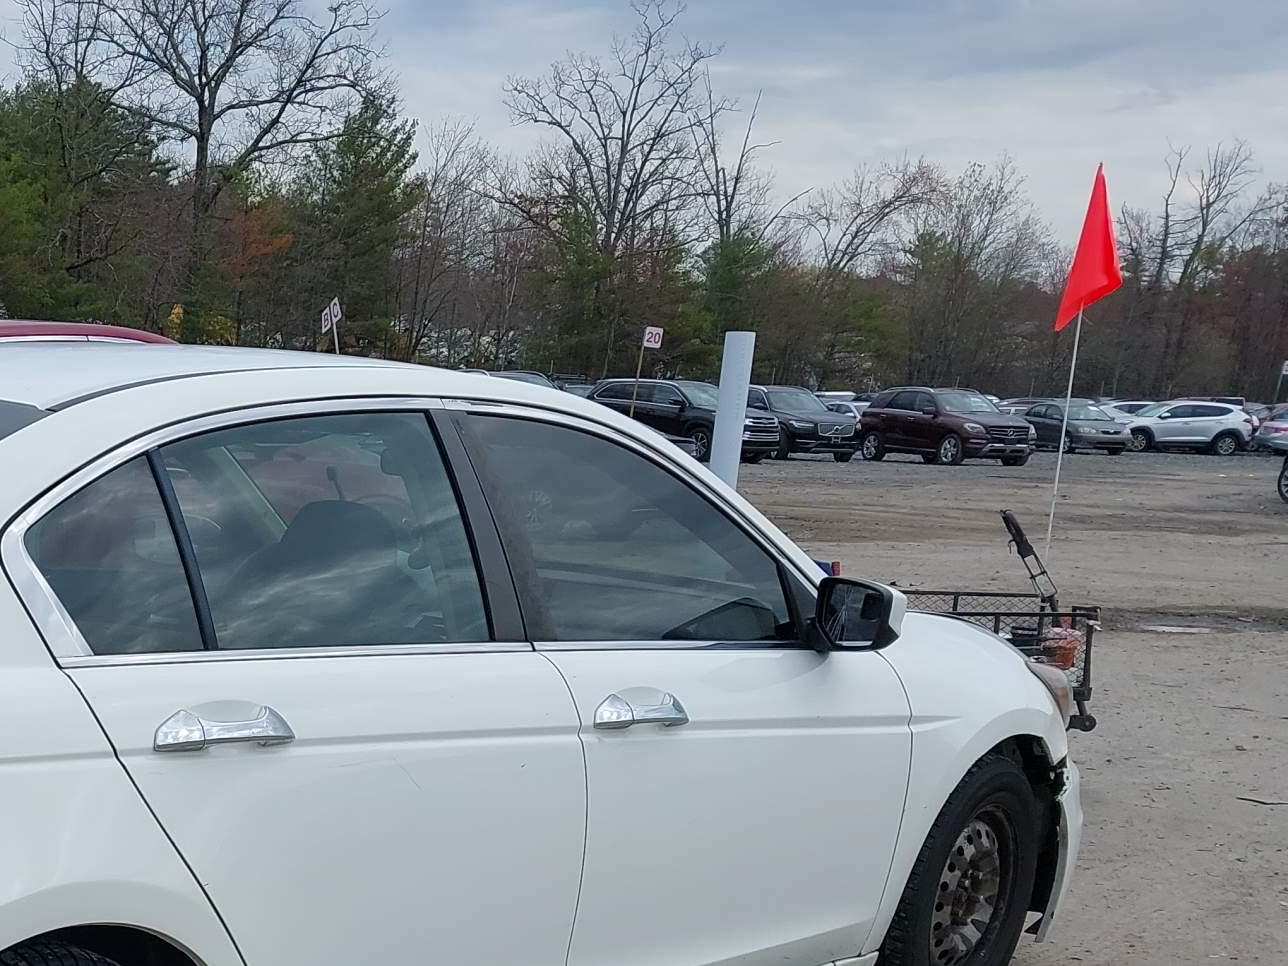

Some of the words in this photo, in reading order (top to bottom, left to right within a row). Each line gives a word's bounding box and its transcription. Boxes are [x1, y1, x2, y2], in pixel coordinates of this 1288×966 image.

[332, 302, 339, 319] C
[323, 312, 330, 328] B
[646, 331, 661, 344] 20
